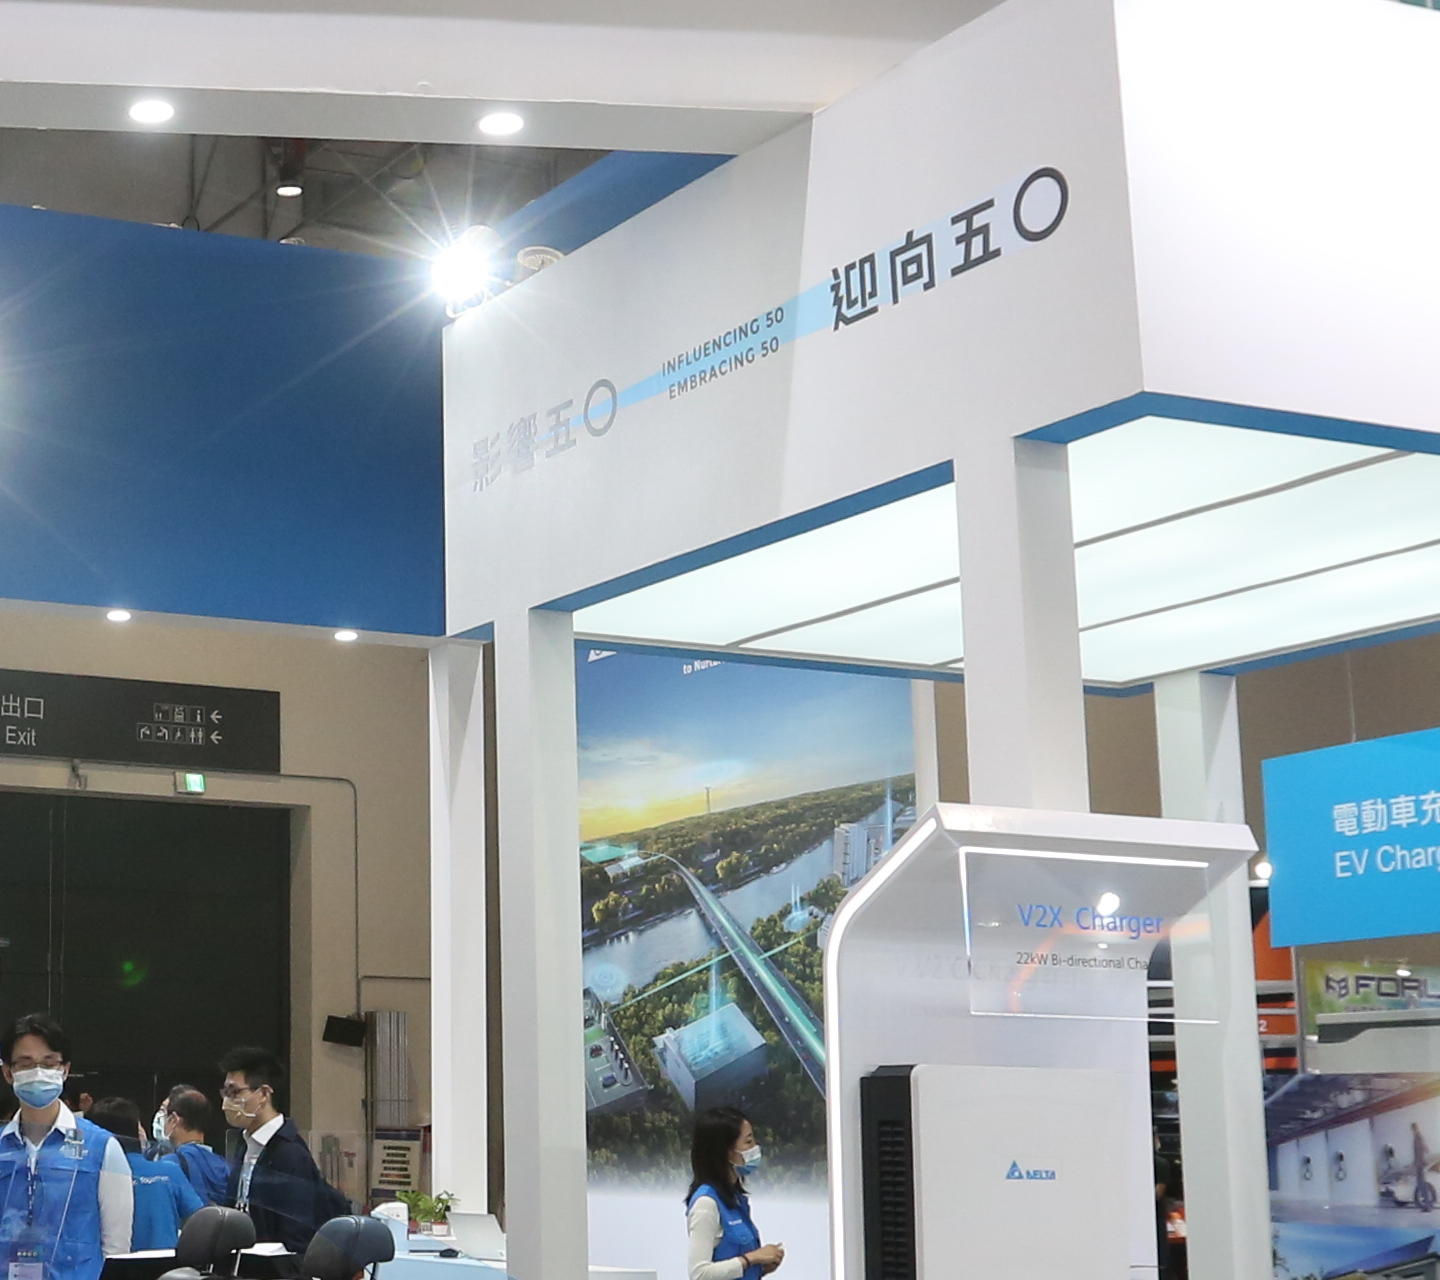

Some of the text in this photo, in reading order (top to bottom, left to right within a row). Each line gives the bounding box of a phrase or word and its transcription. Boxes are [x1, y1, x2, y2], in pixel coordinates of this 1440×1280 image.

[662, 306, 785, 378] INFLUENCING 50
[669, 336, 780, 401] EMBRACING 50
[0, 693, 45, 720] 出口
[5, 725, 37, 747] Exit
[1333, 850, 1368, 879] EV
[1017, 904, 1164, 940] V2X Charger
[1015, 951, 1150, 970] 22kW Bi-directional Cha
[1025, 1169, 1056, 1180] DELTA
